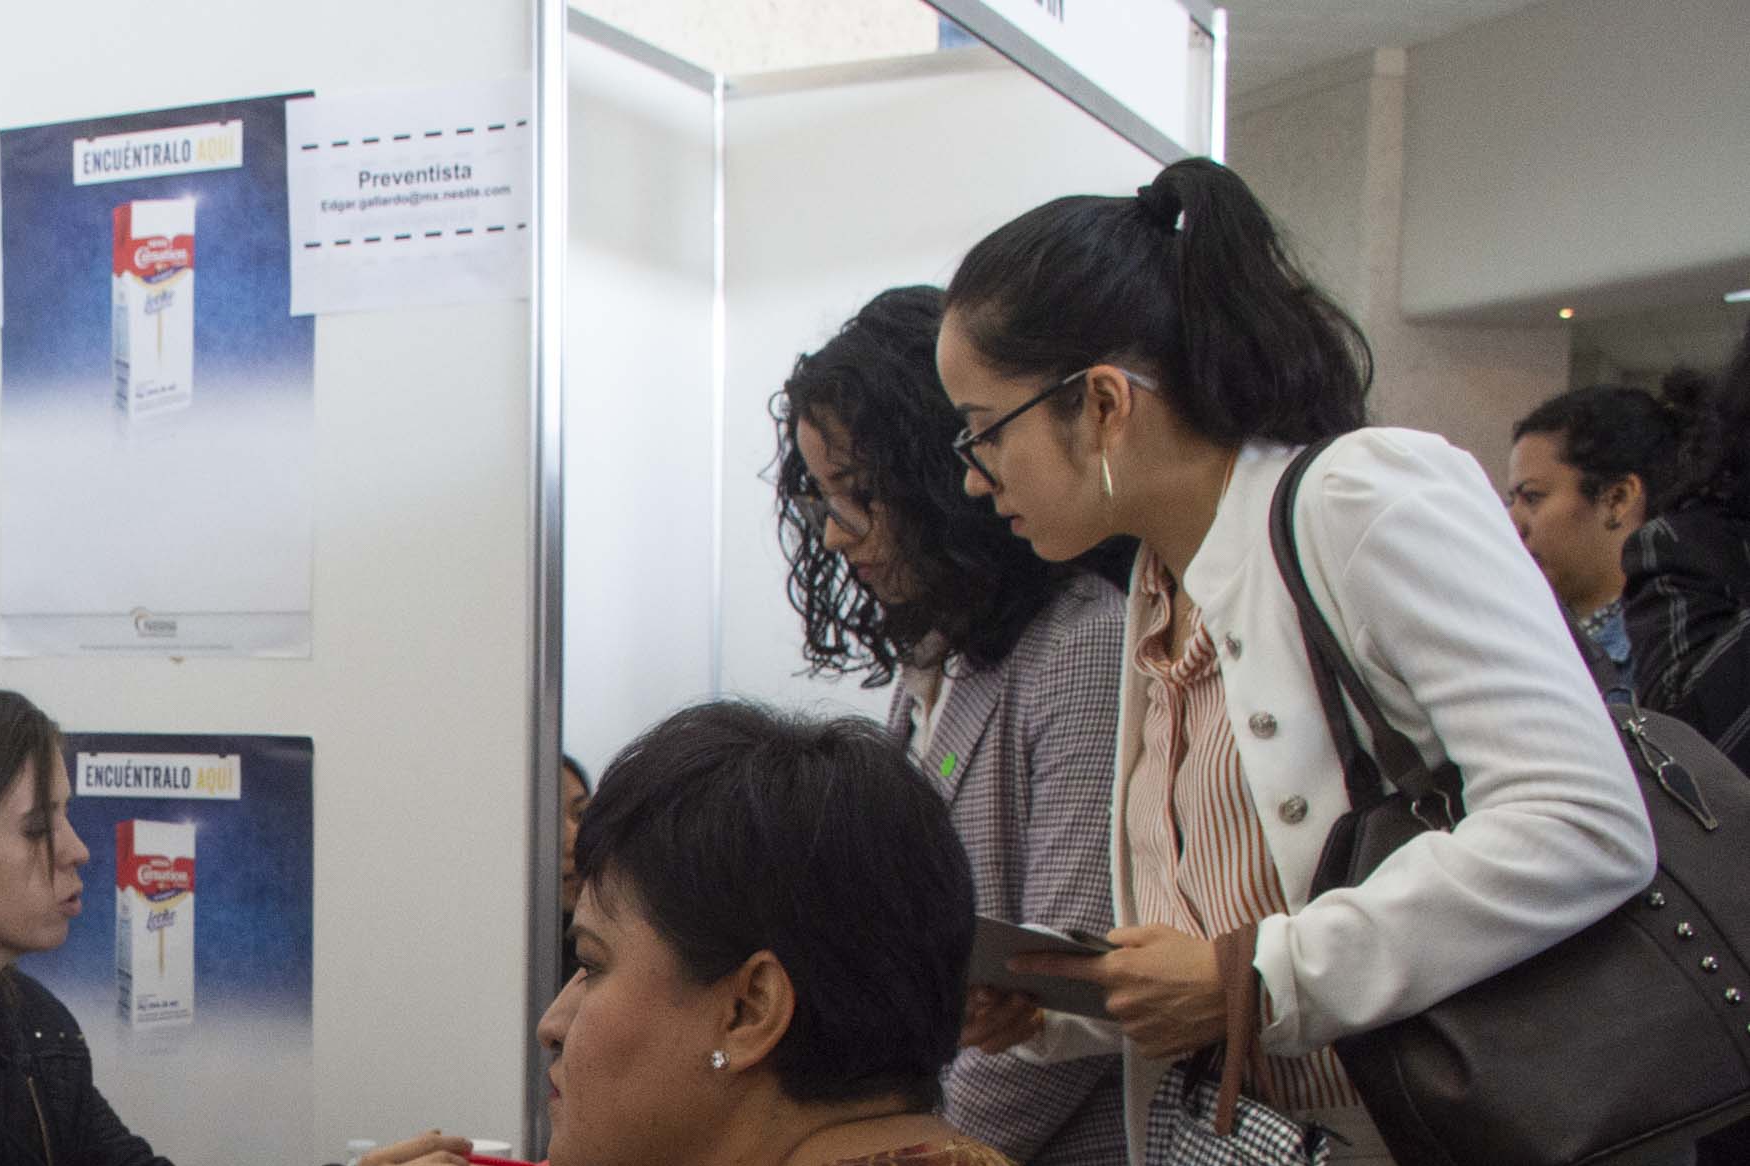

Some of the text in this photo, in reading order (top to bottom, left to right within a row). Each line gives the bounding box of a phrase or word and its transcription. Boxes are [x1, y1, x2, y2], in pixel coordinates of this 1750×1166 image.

[83, 139, 191, 175] ENCUÉNTRALO
[359, 163, 472, 189] Preventista
[86, 760, 191, 788] ENCUÉNTRALO
